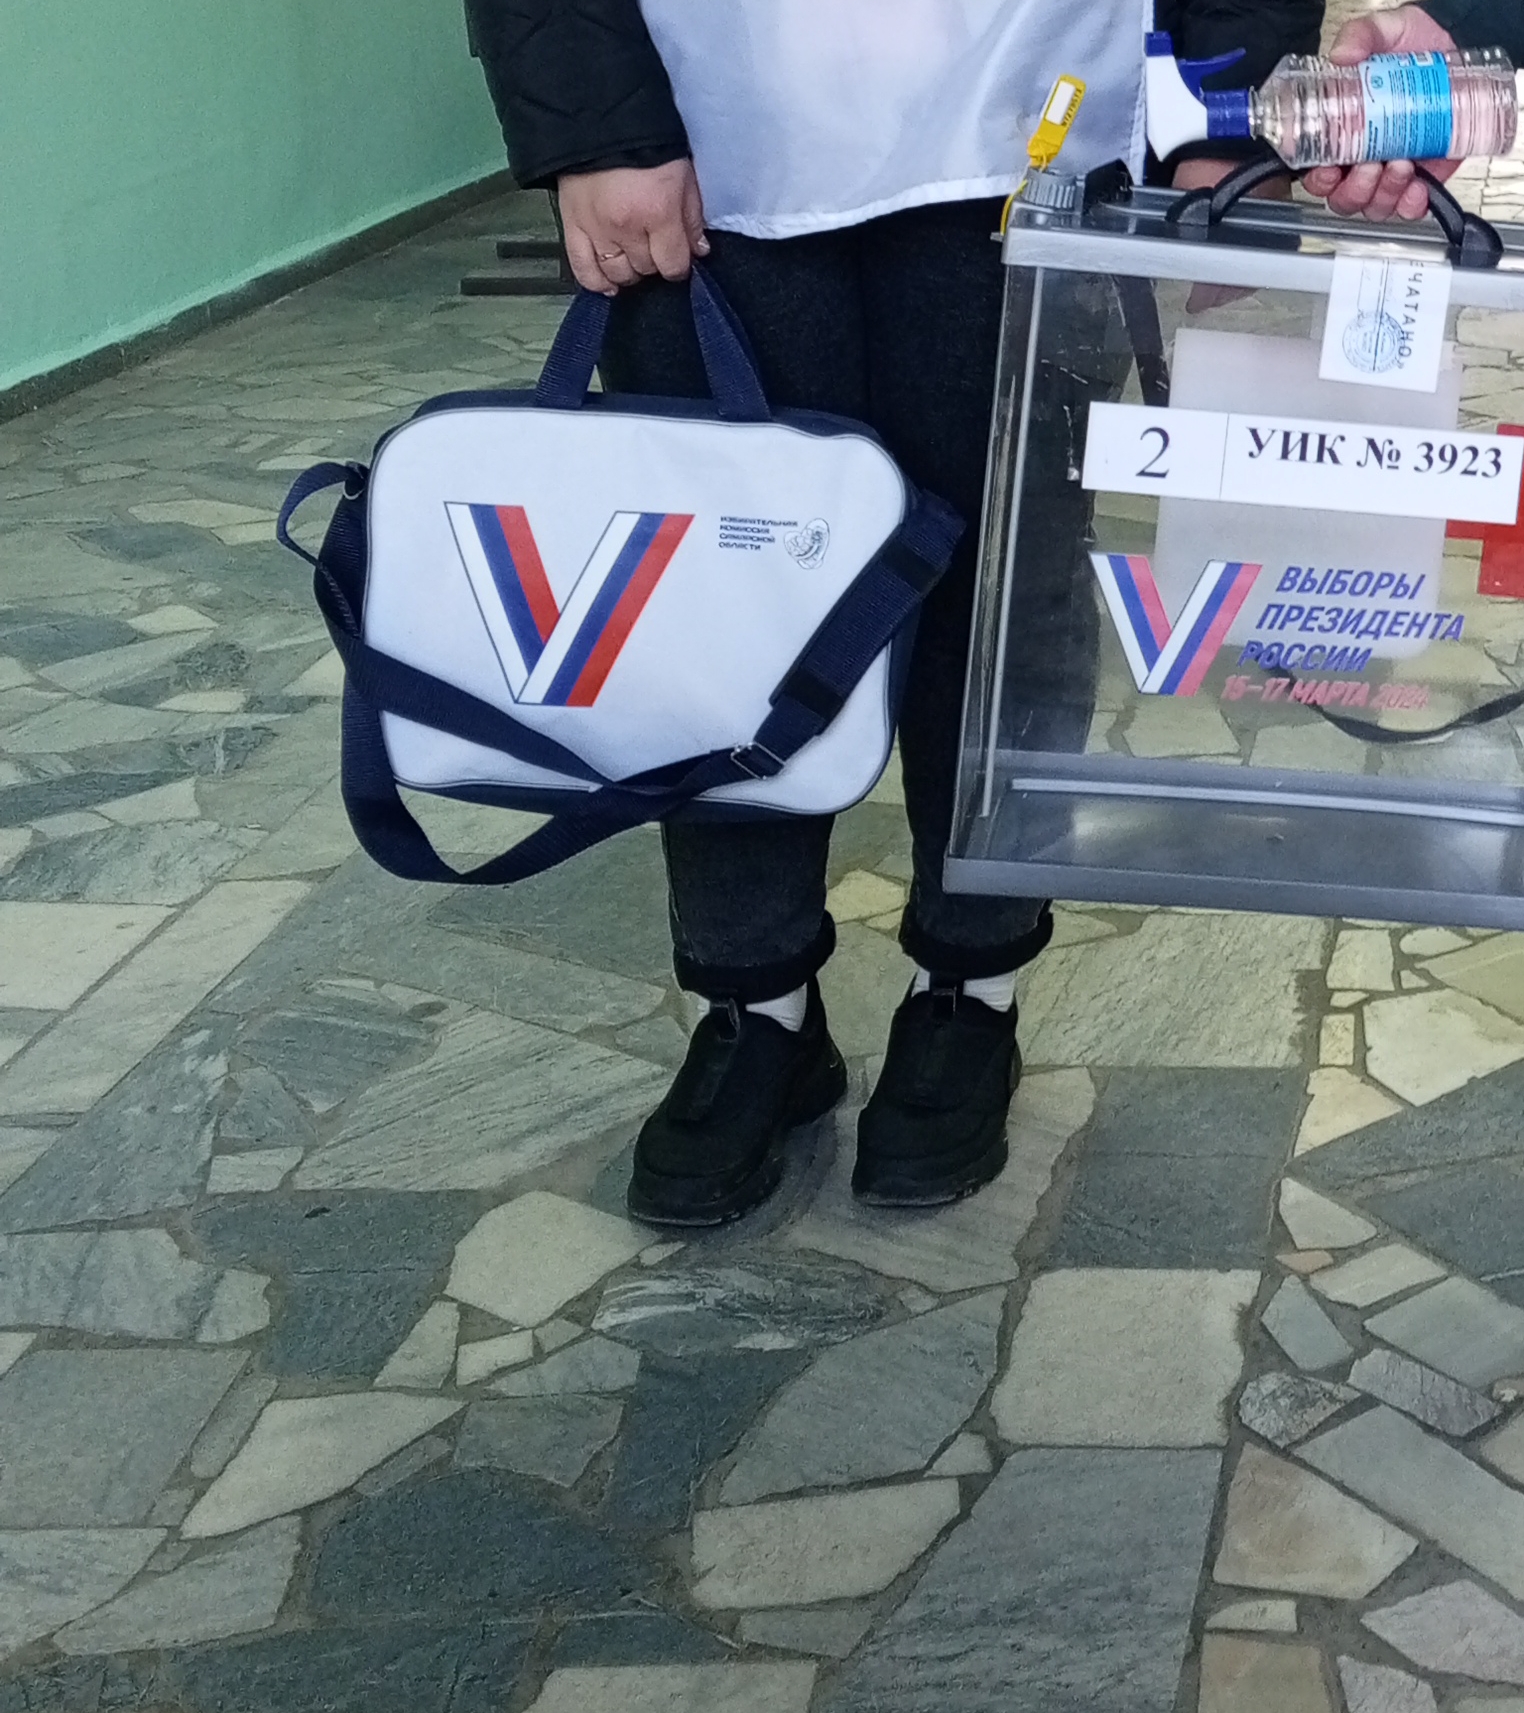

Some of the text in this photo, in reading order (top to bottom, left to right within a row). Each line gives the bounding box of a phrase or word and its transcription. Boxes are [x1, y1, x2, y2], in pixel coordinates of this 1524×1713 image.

[1135, 425, 1172, 480] 2
[1246, 426, 1503, 480] УИК № 3923
[1275, 565, 1427, 600] ВЫБОРЫ
[1255, 603, 1466, 642] ПРЕЗИДЕНТА
[1235, 639, 1374, 673] РОССИИ
[1287, 676, 1371, 708] МАРТА
[1369, 681, 1430, 710] 2024
